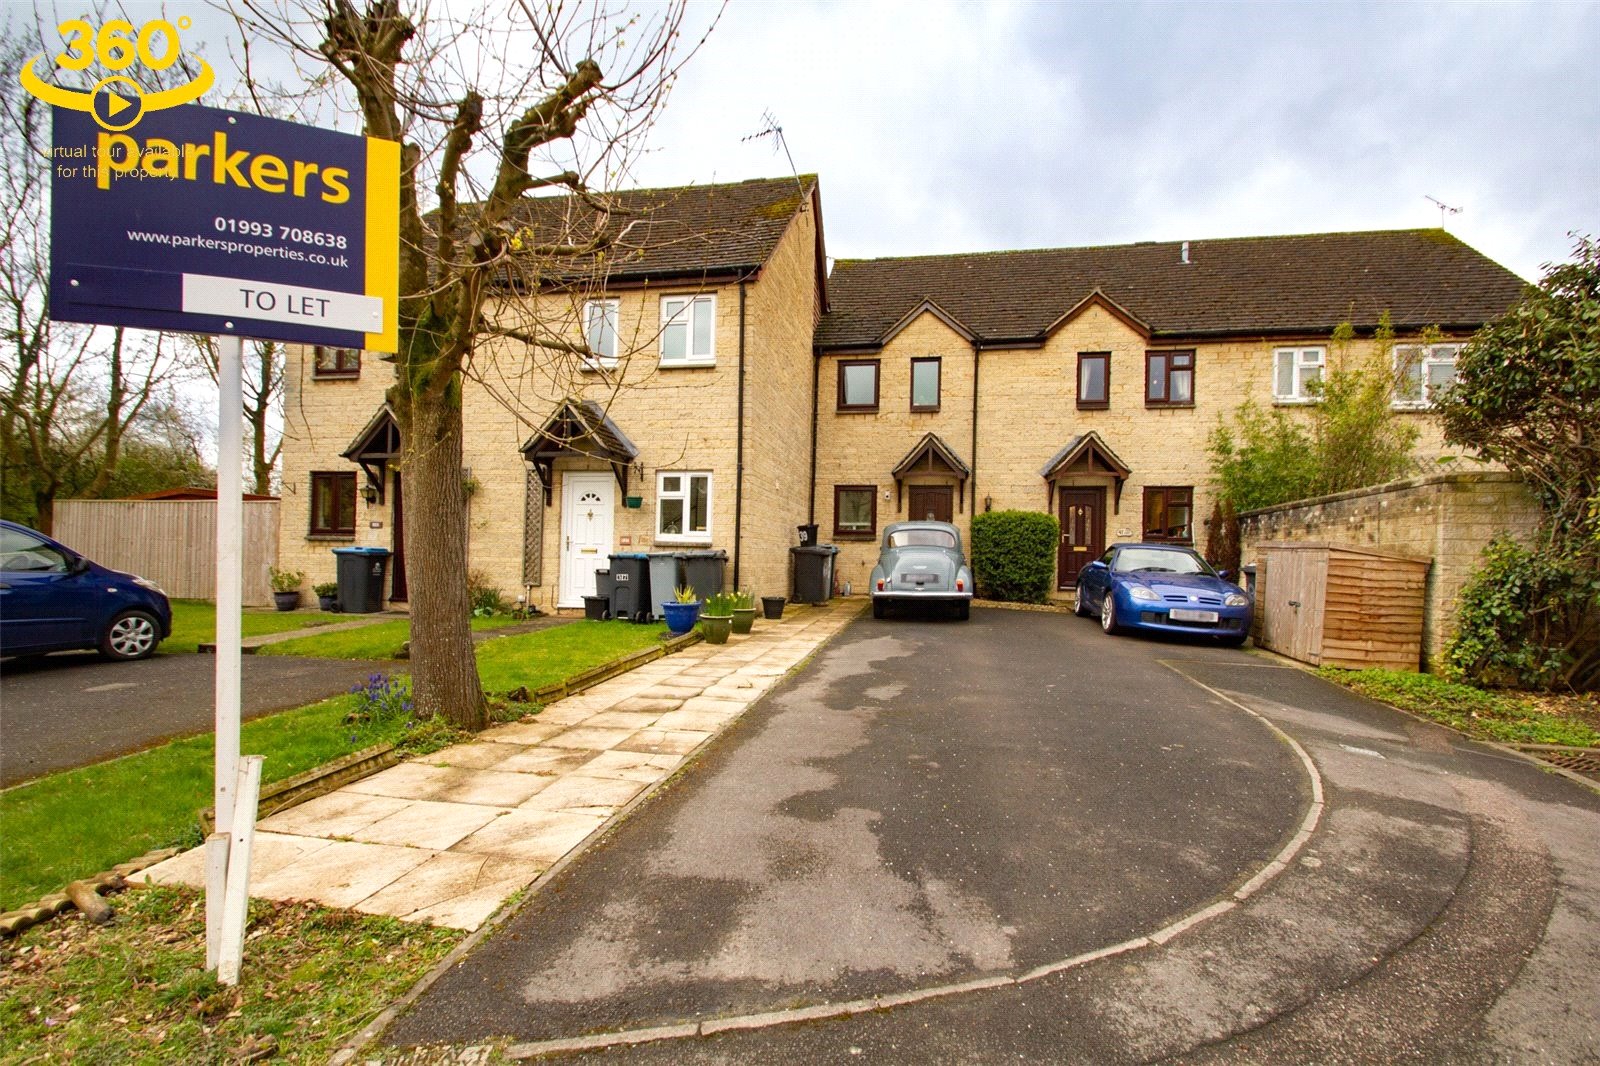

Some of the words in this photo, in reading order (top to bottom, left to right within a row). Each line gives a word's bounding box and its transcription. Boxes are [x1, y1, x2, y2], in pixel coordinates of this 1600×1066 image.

[96, 129, 351, 205] parkers
[126, 229, 349, 268] www.parkersproperties.co.uk
[214, 216, 274, 239] 01993
[279, 225, 348, 250] 708638
[239, 288, 277, 312] TO
[287, 294, 331, 318] LET
